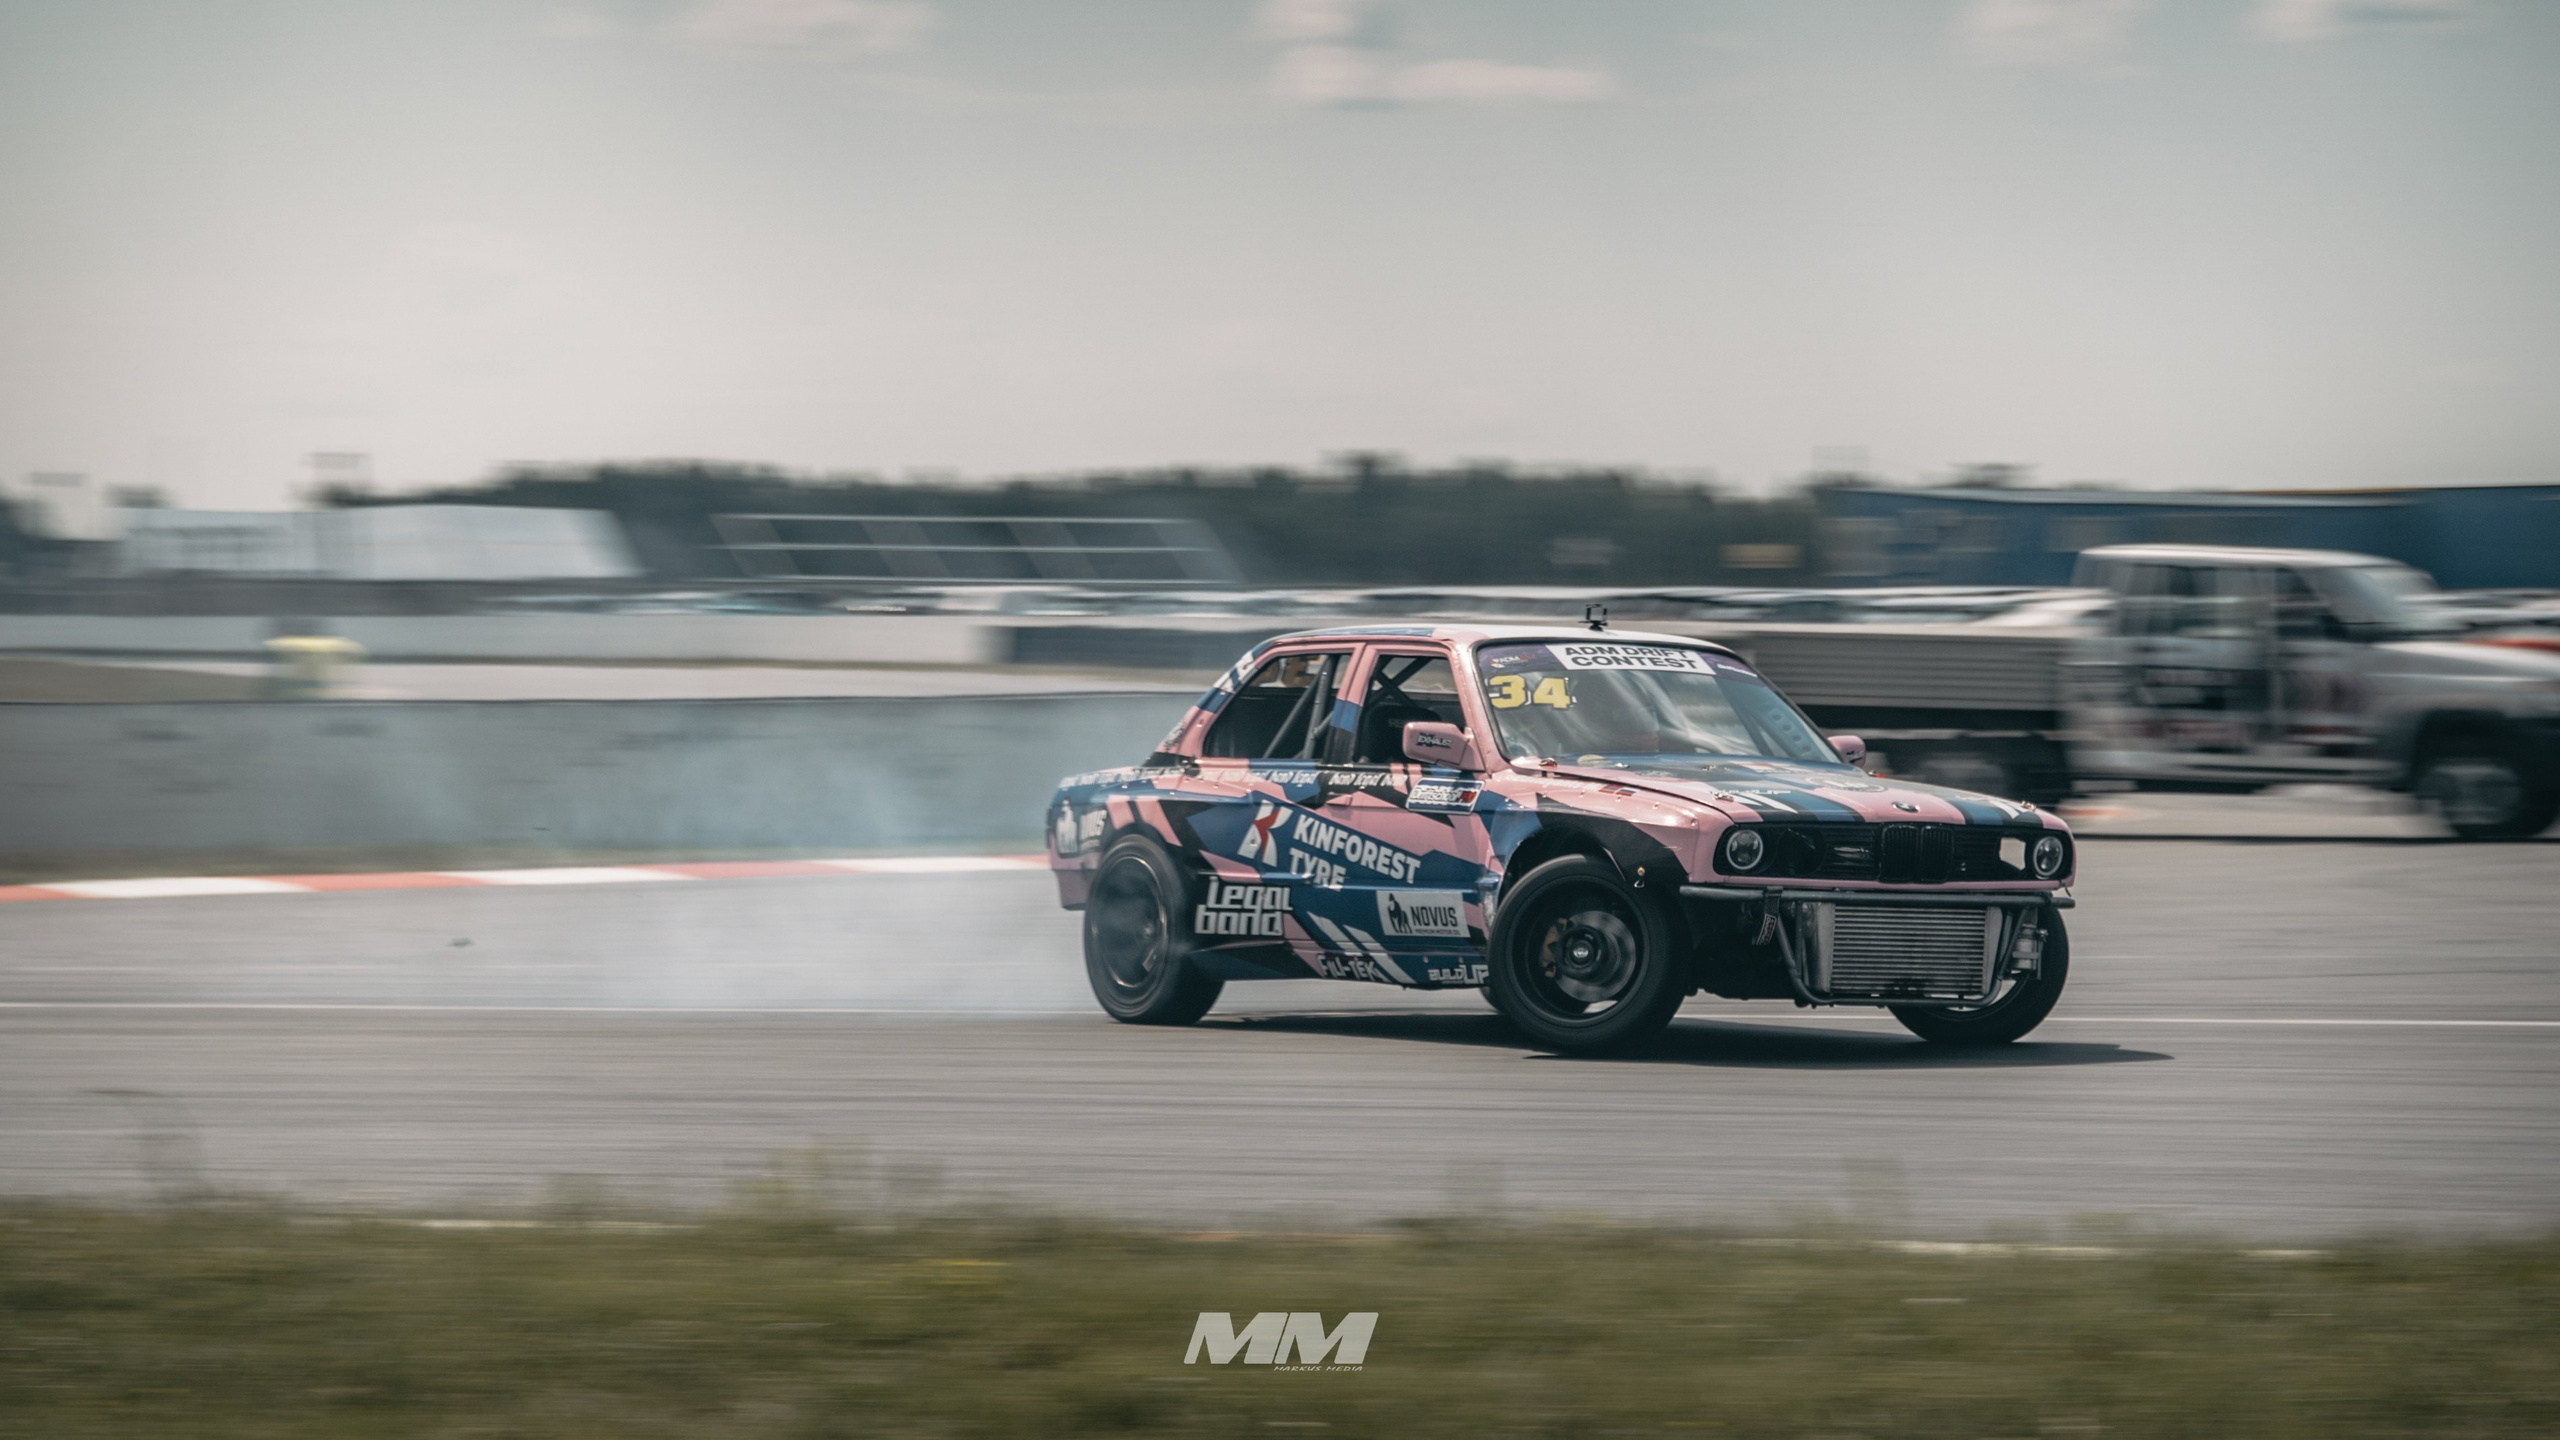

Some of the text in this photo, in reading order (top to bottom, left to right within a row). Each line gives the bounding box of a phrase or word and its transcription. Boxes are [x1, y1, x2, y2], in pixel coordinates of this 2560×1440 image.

[1565, 646, 1689, 659] ADM DRIFT
[1571, 656, 1698, 670] CONTEST
[1489, 674, 1571, 710] 34
[1293, 814, 1421, 885] KINFOREST
[1289, 847, 1346, 892] TYRE
[1410, 905, 1458, 928] NOVUS
